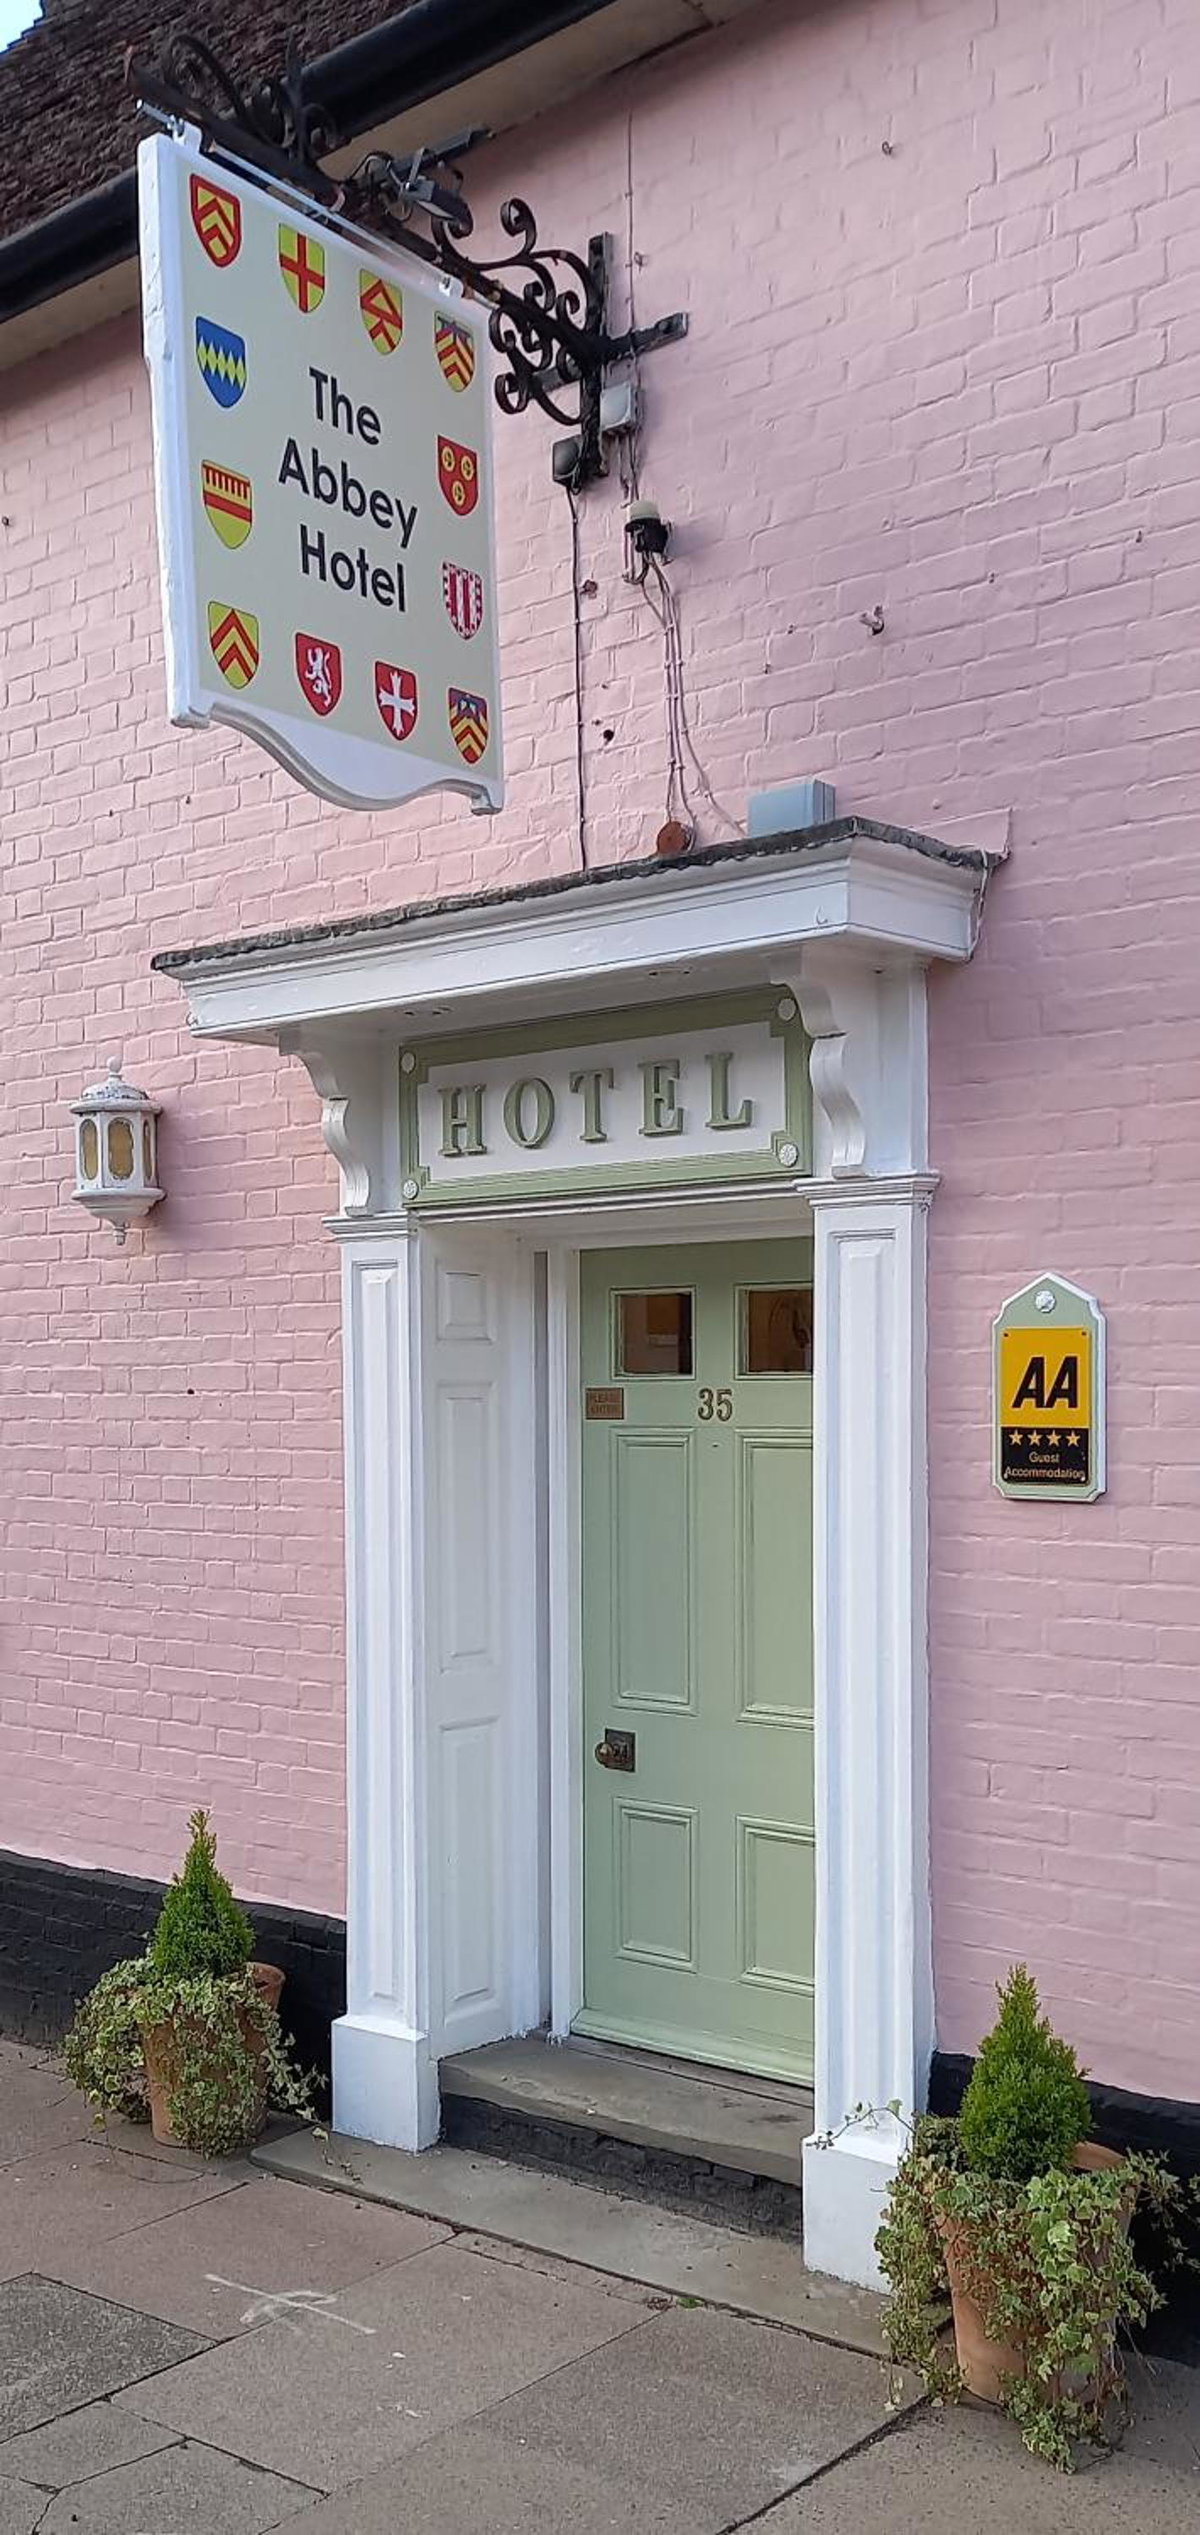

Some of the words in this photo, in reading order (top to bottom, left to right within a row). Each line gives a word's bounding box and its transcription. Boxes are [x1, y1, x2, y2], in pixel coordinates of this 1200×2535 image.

[309, 366, 381, 445] The
[278, 437, 418, 549] Abbey
[300, 523, 406, 612] Hotel
[437, 1051, 753, 1157] HOTEL
[697, 1388, 733, 1421] 35
[1012, 1357, 1078, 1408] AA
[1005, 1466, 1086, 1479] Accommodation
[1028, 1451, 1060, 1463] Guest
